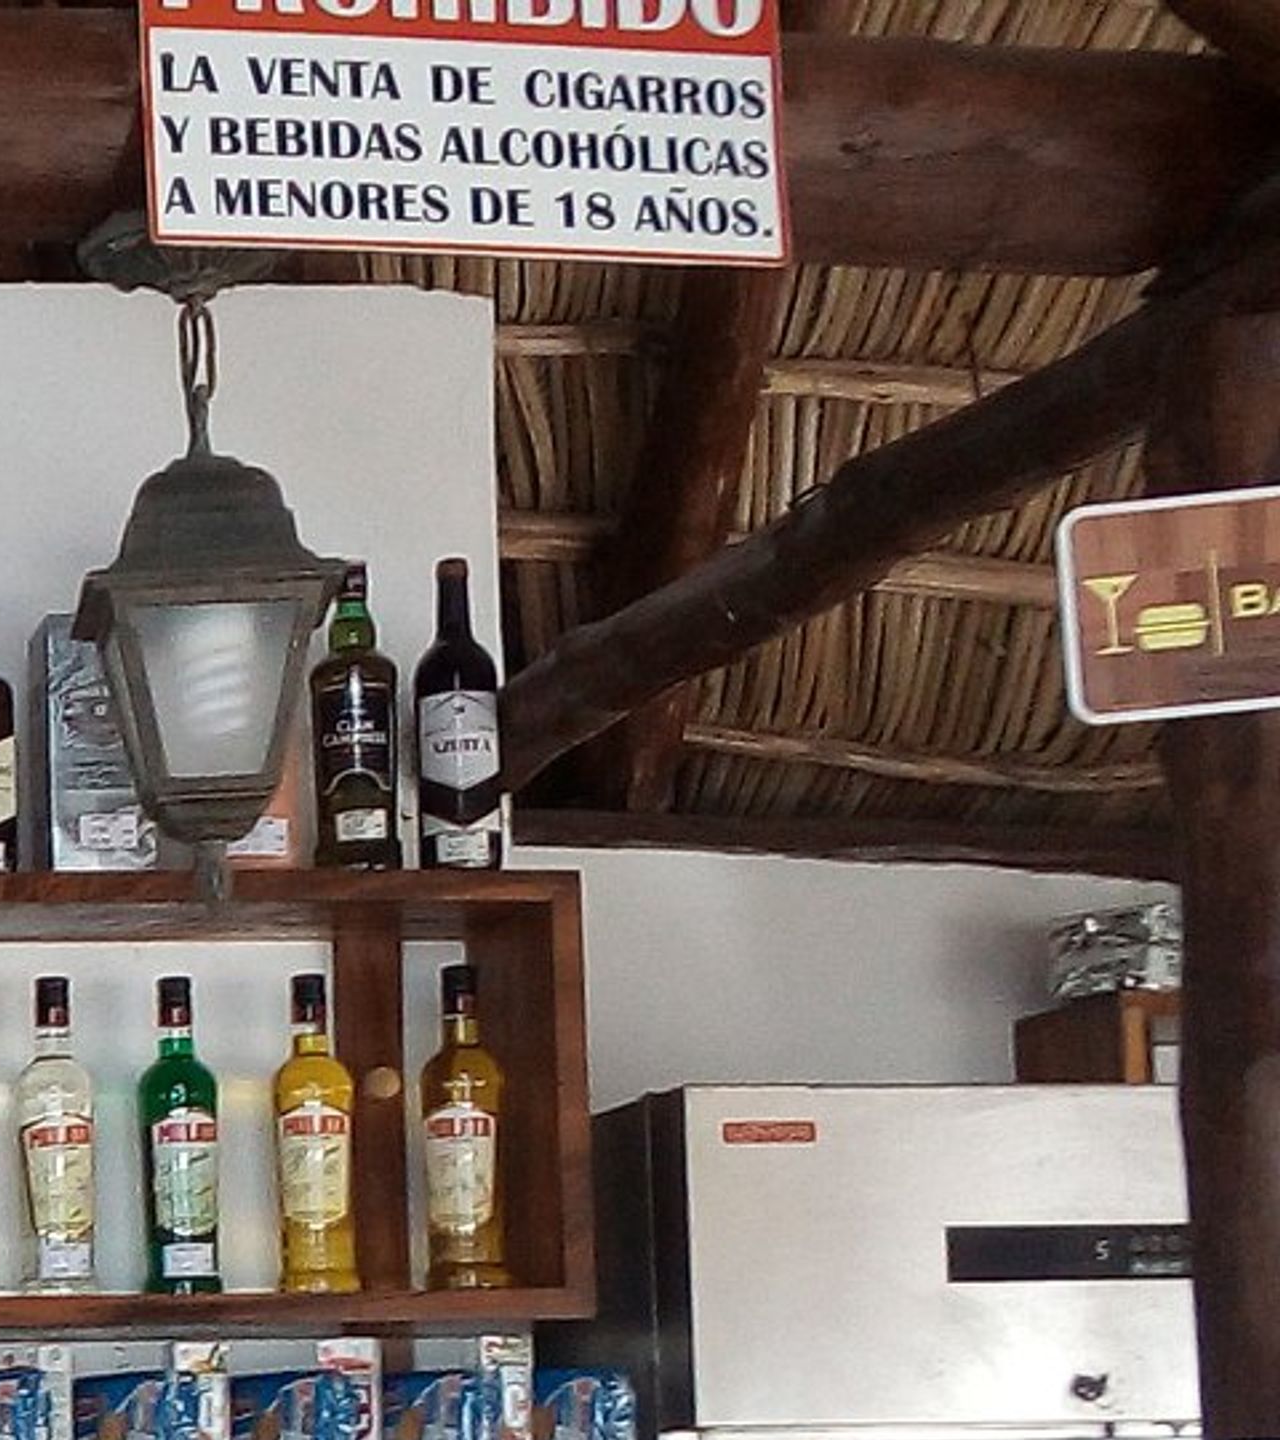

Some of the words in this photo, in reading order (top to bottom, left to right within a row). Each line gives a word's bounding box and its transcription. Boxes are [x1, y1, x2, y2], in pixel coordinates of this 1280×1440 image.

[160, 53, 219, 94] LA
[248, 57, 400, 100] VENTA
[431, 66, 496, 105] DE
[525, 70, 766, 119] CIGARROS
[161, 115, 192, 152] Y
[209, 118, 423, 162] BEBIDAS
[441, 123, 770, 178] ALCOHÓLICAS
[164, 178, 197, 214] A
[215, 179, 450, 223] MENORES
[470, 189, 535, 227] DE
[556, 192, 616, 230] 18
[635, 186, 775, 237] AÑOS.
